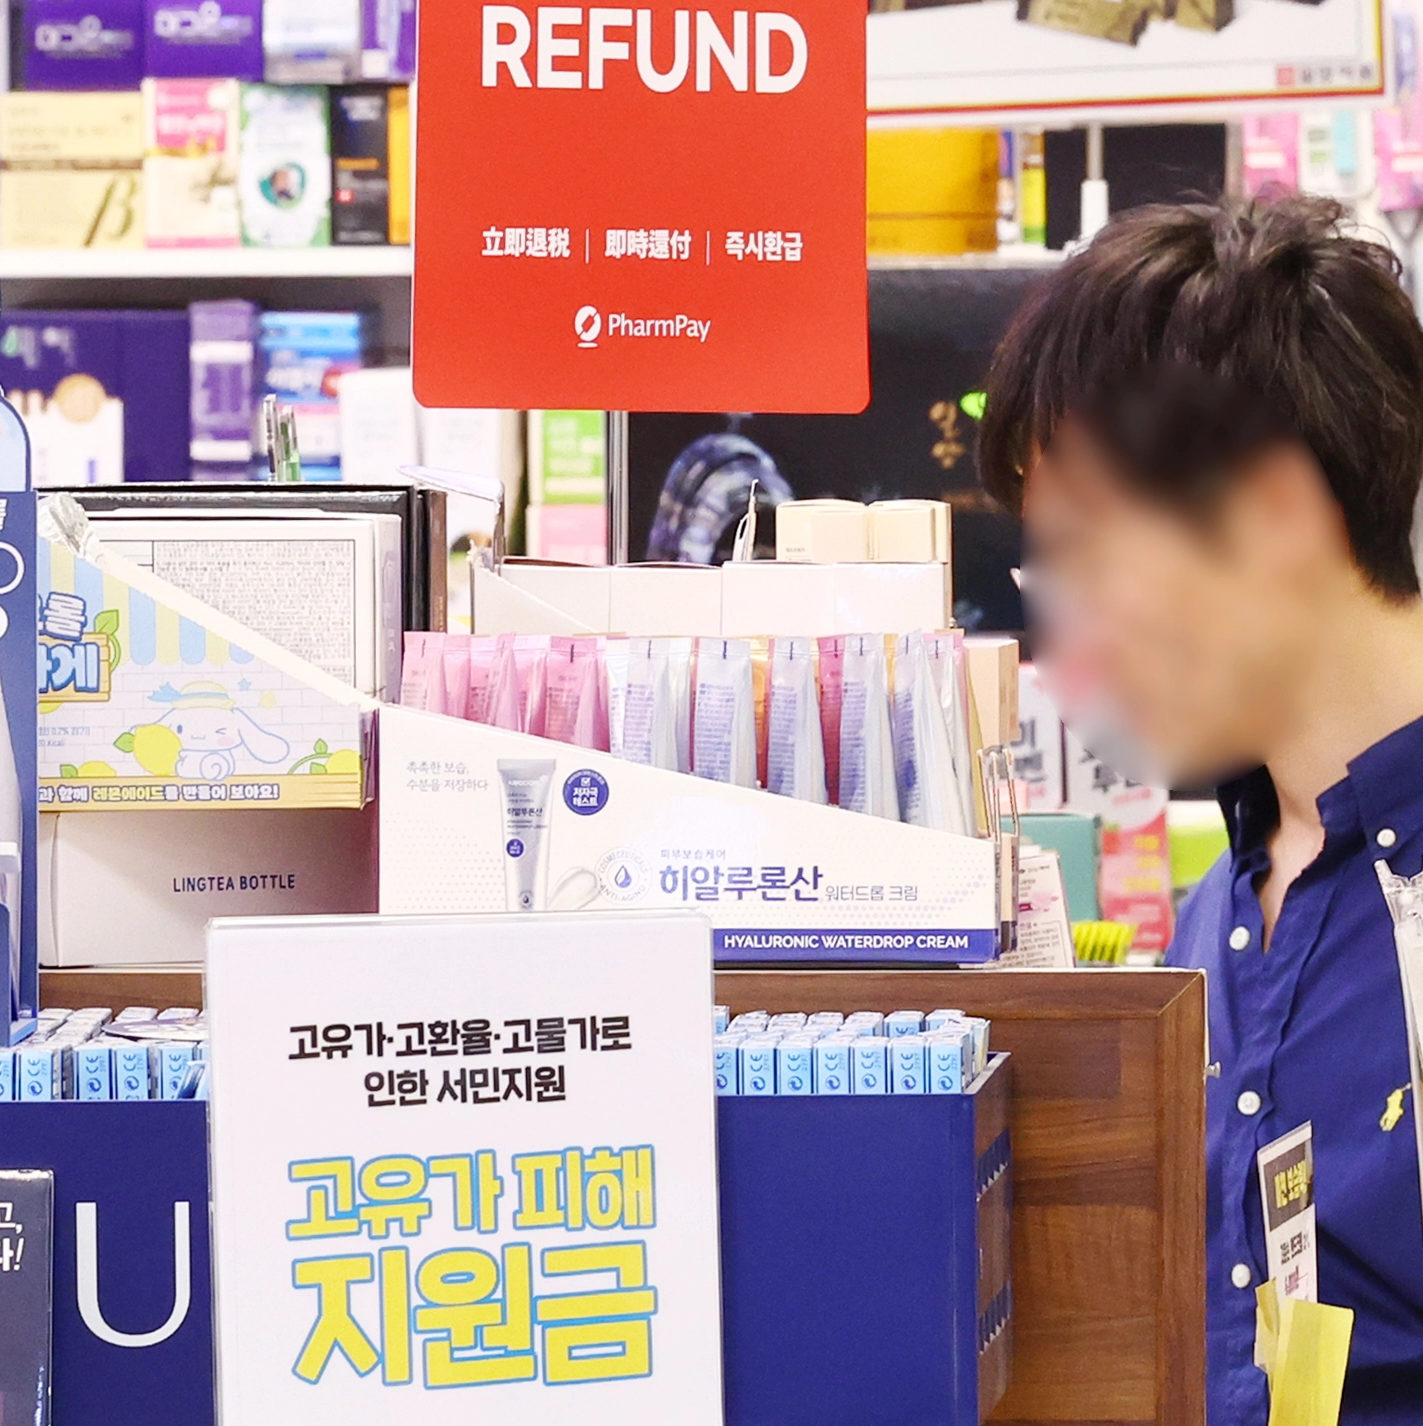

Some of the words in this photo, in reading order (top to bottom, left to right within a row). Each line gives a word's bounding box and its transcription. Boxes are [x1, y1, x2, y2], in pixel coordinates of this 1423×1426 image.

[481, 5, 808, 93] REFUND
[725, 231, 803, 262] 즉시환급
[608, 313, 711, 343] PharmPay
[92, 785, 180, 802] 레몬에이드를
[182, 785, 226, 801] 만들어
[230, 784, 280, 800] 보아요!
[172, 876, 235, 893] LINGTEA
[239, 874, 296, 891] BOTTLE
[659, 865, 823, 901] 히알루론산
[825, 885, 884, 901] 워터드롭
[889, 885, 919, 901] 크림
[724, 935, 819, 949] HYALURONIC
[821, 934, 914, 949] WATERDROP
[916, 934, 968, 948] CREAM
[364, 1069, 428, 1107] 인한
[436, 1065, 566, 1104] 서민지원
[286, 1149, 504, 1240] 고유가
[513, 1144, 657, 1231] 피해
[291, 1240, 659, 1389] 지원금
